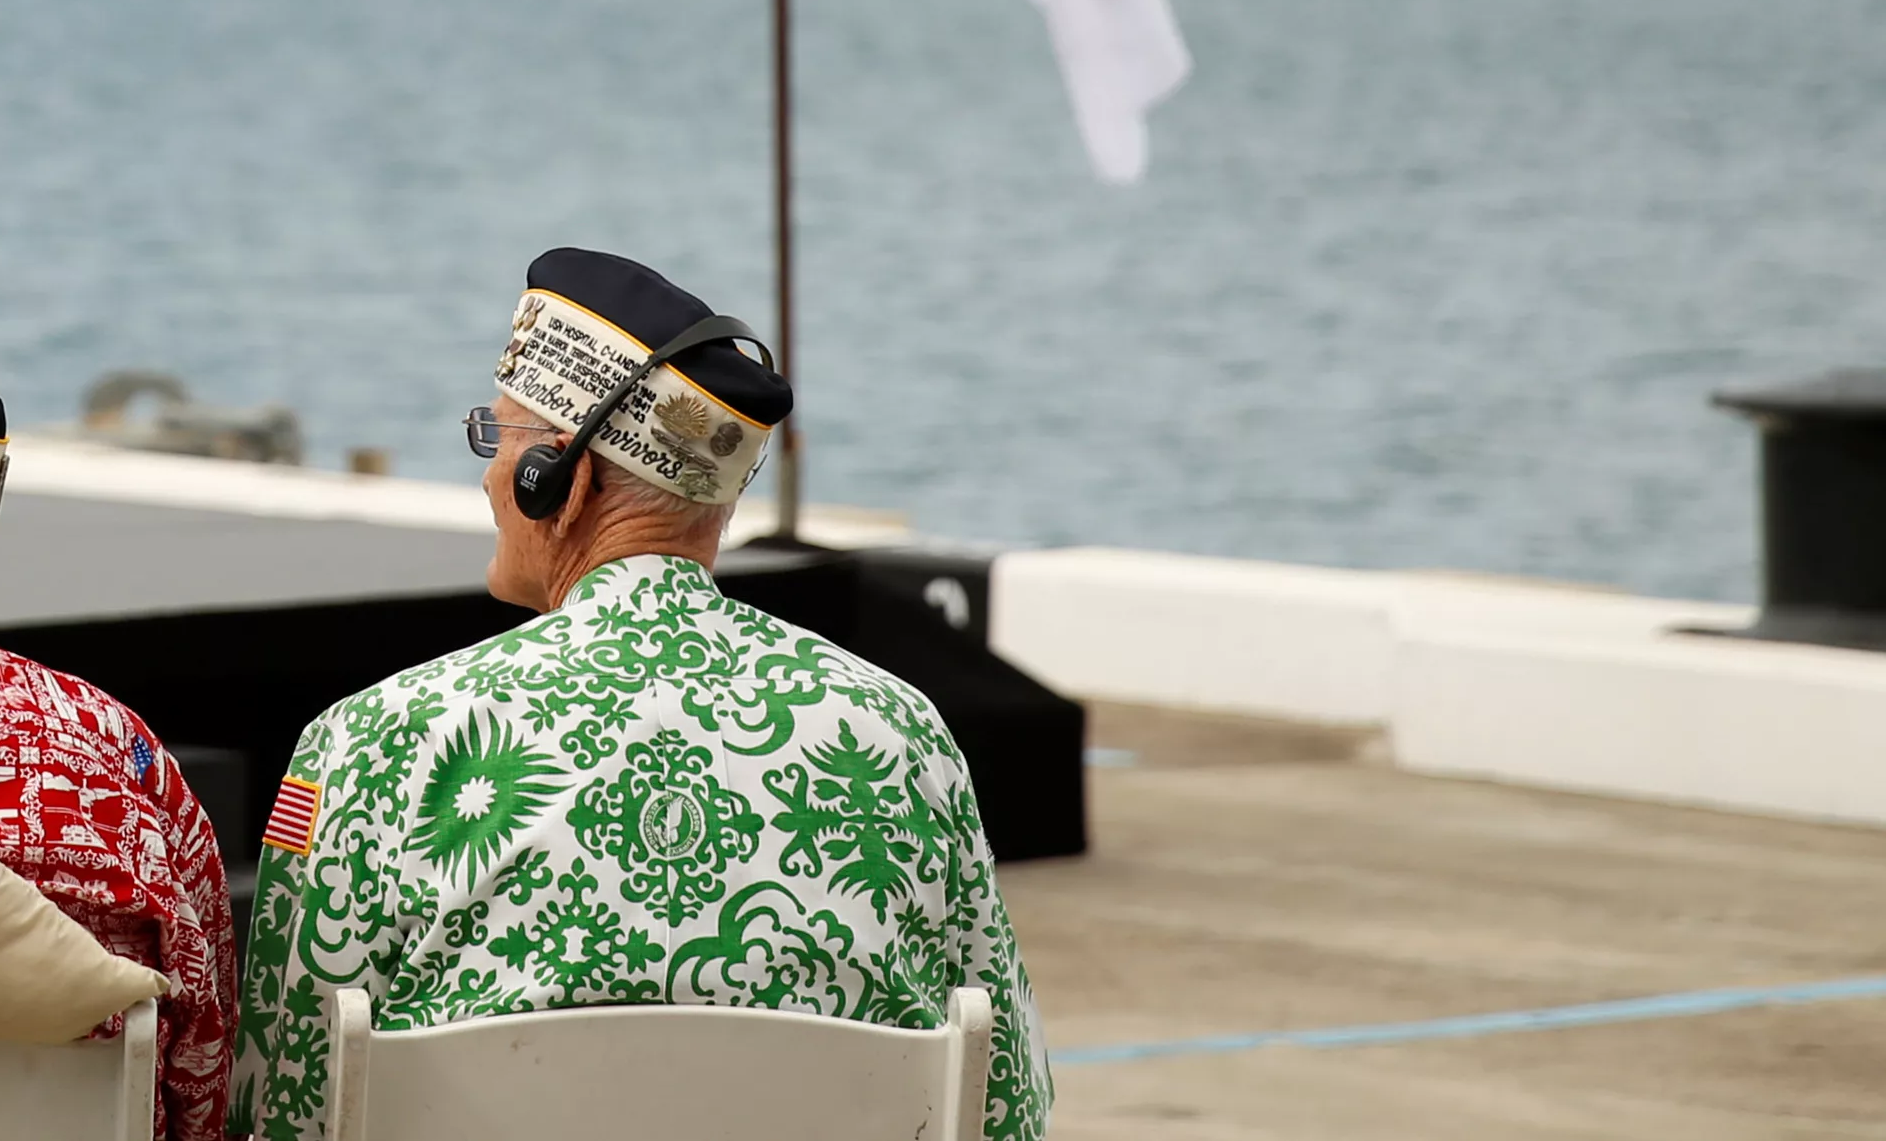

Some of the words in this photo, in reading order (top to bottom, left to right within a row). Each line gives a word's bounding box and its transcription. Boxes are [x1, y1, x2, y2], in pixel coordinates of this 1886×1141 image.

[548, 316, 565, 333] USN
[562, 323, 598, 354] HOSPITAL,
[557, 367, 606, 399] BARRACKS
[600, 363, 613, 375] OF
[631, 394, 652, 413] 1941
[515, 367, 575, 418] Harbor
[569, 403, 683, 480] Srvivors
